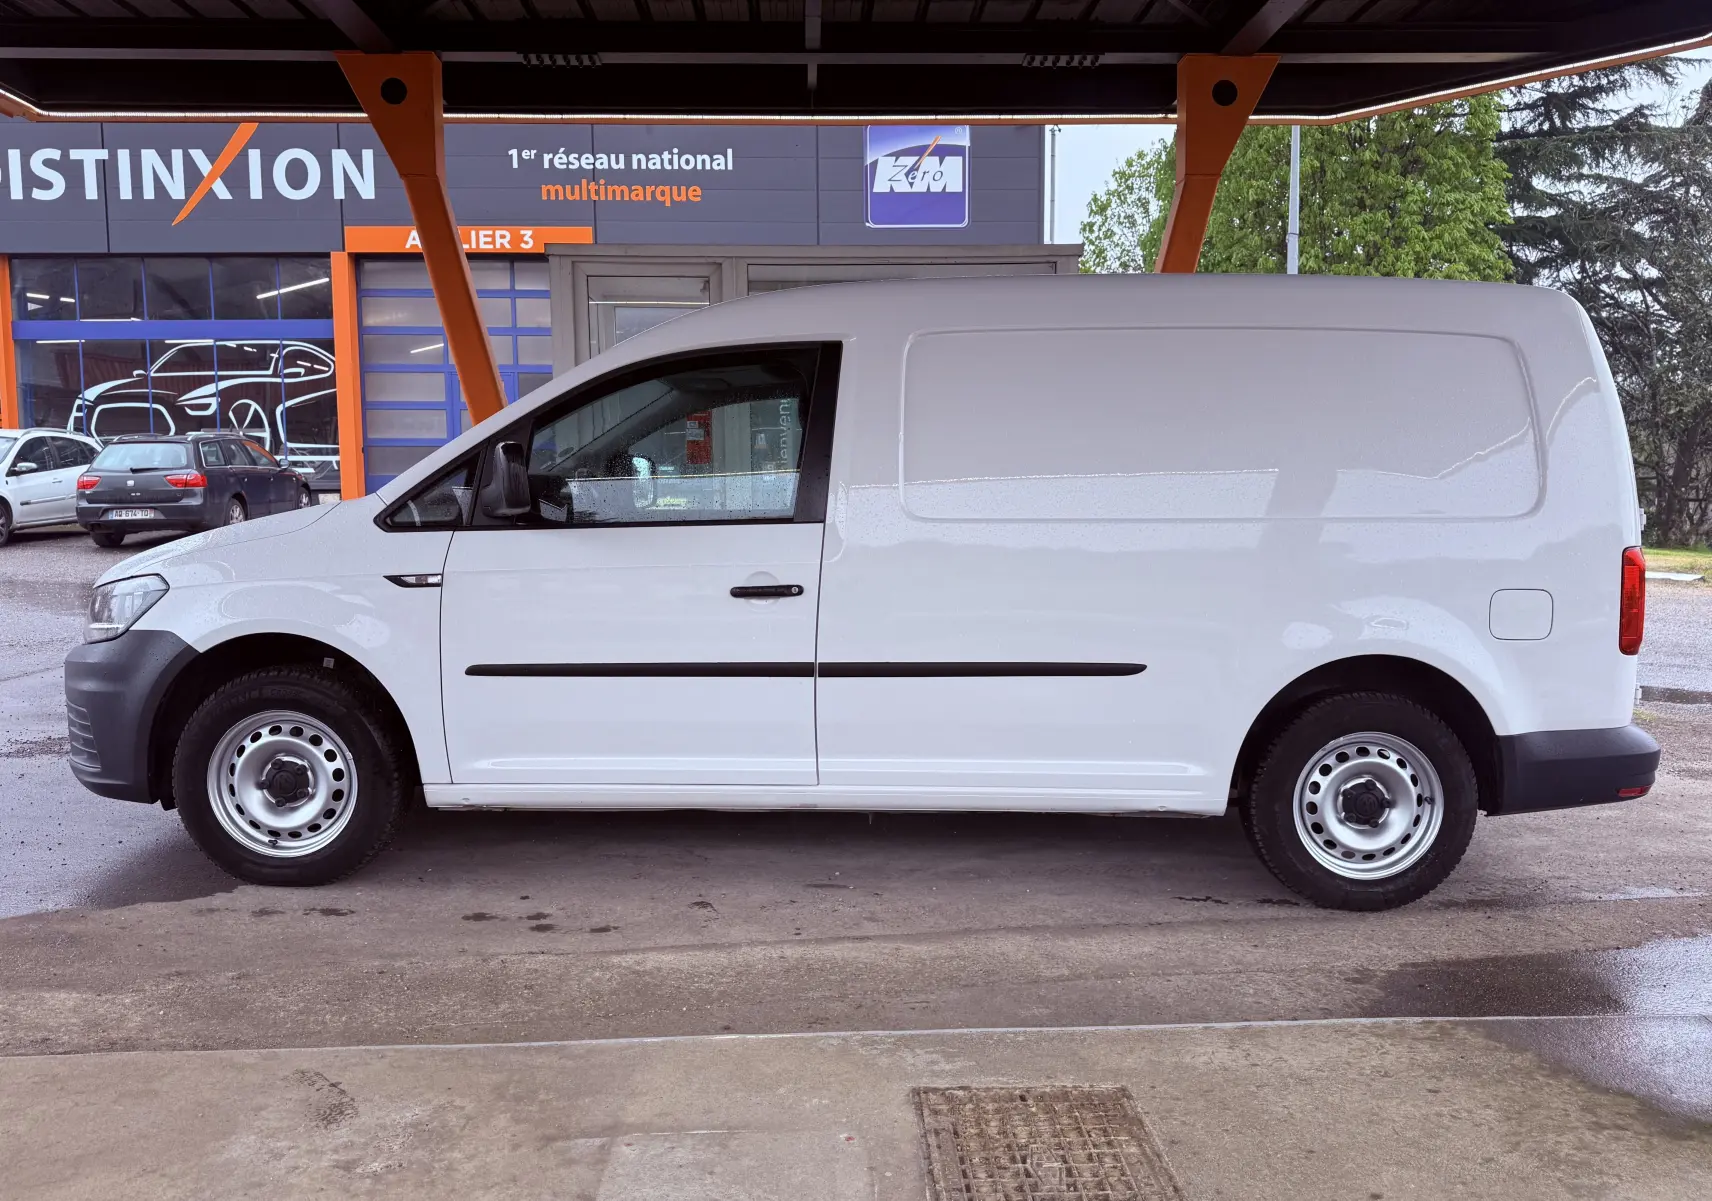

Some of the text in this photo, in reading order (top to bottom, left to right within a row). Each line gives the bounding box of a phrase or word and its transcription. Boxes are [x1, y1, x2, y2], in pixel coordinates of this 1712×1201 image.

[508, 147, 733, 170] 1er réseau national
[0, 123, 376, 226] ISTINXION
[873, 156, 963, 193] KM
[887, 164, 944, 182] Zero
[541, 179, 702, 206] multimarque
[405, 230, 534, 249] AIER 3
